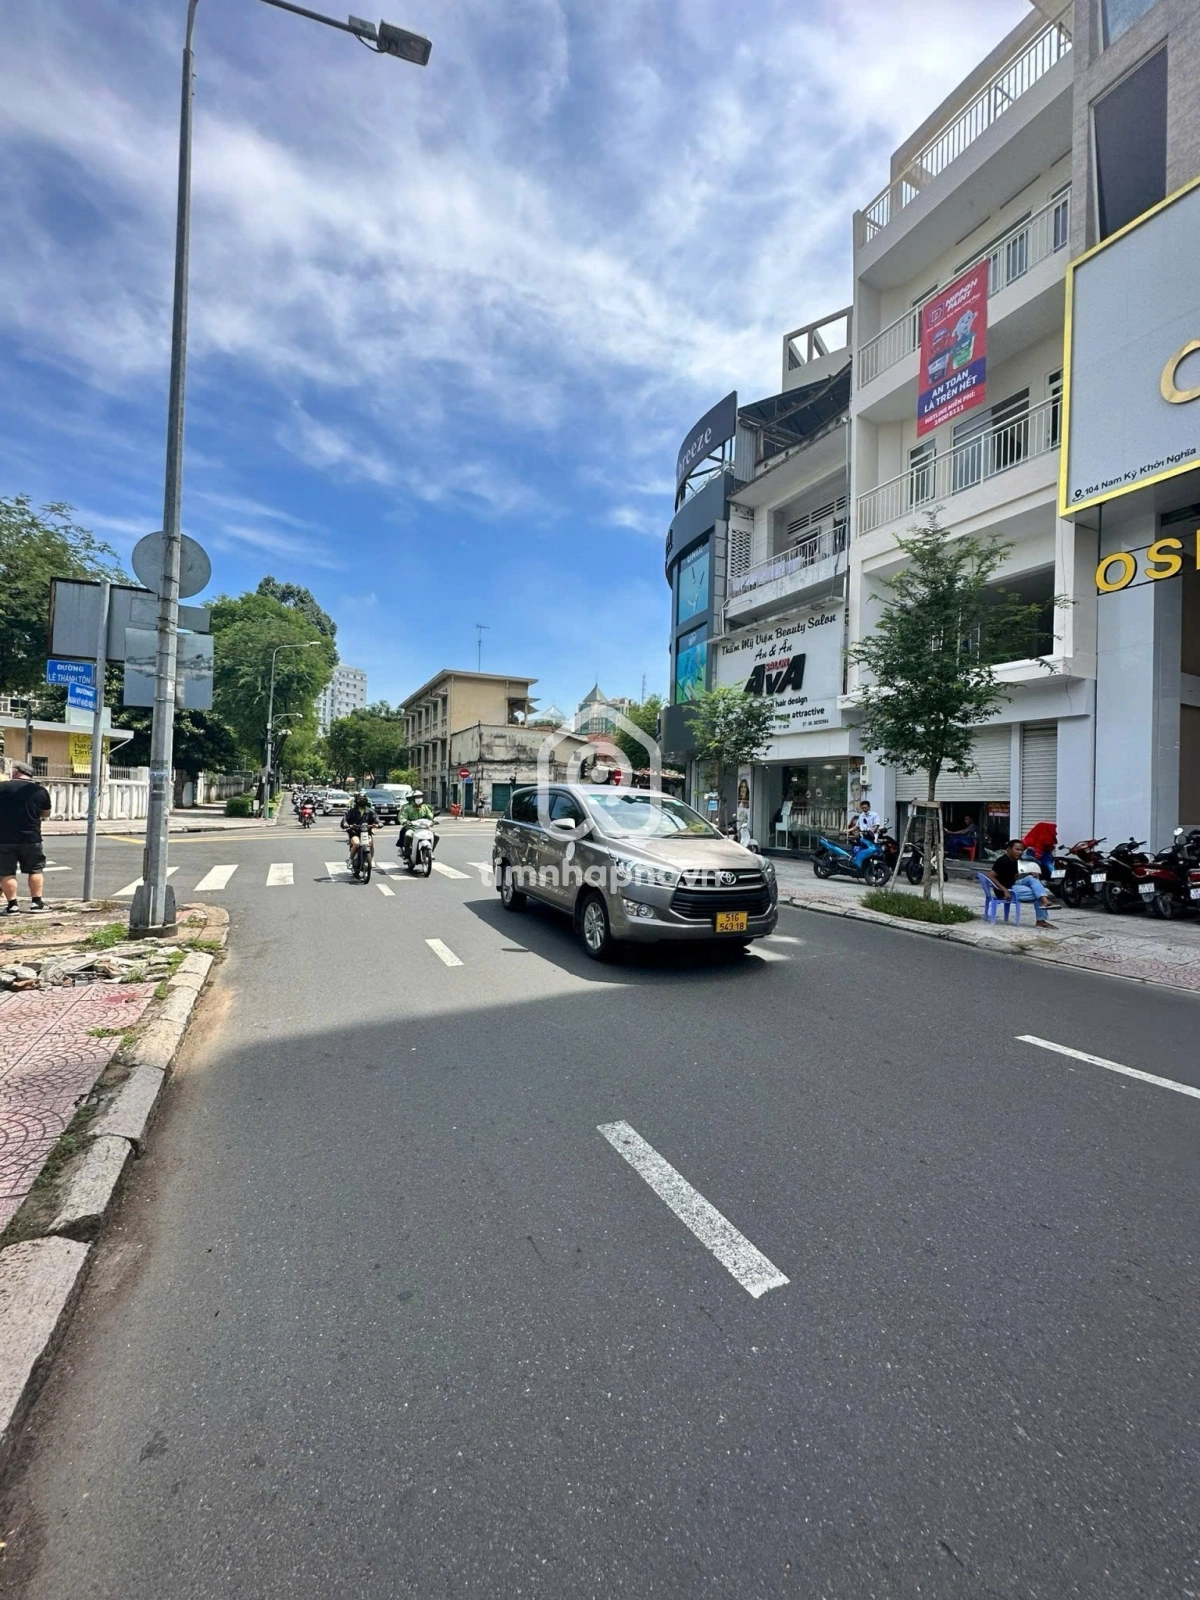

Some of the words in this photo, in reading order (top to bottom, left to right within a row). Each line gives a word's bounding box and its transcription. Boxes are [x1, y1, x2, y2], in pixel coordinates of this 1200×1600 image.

[945, 278, 978, 307] NIPPON
[946, 289, 972, 312] PAINT
[932, 384, 944, 398] AN
[945, 368, 969, 390] TOÀN
[924, 400, 934, 413] LÀ
[936, 386, 958, 406] TRÊN
[960, 374, 978, 392] HẾT
[924, 406, 948, 424] HOTLINE
[1084, 484, 1100, 495] 104
[1101, 476, 1122, 490] Nam
[1140, 460, 1164, 475] Khởi
[1166, 448, 1197, 464] Nghĩa
[742, 638, 754, 650] Mỹ
[756, 633, 774, 646] Viện
[775, 622, 806, 639] Beauty
[807, 614, 837, 629] Salon
[754, 648, 768, 661] An
[768, 644, 777, 657] &
[57, 664, 84, 672] ĐƯỜNG
[48, 672, 56, 682] LÊ
[58, 673, 78, 682] THÁNH
[78, 674, 91, 684] TÔN
[776, 699, 788, 708] hair
[788, 696, 808, 706] design
[792, 706, 825, 719] attractive
[720, 922, 744, 931] 543.18
[726, 914, 740, 922] 51G
